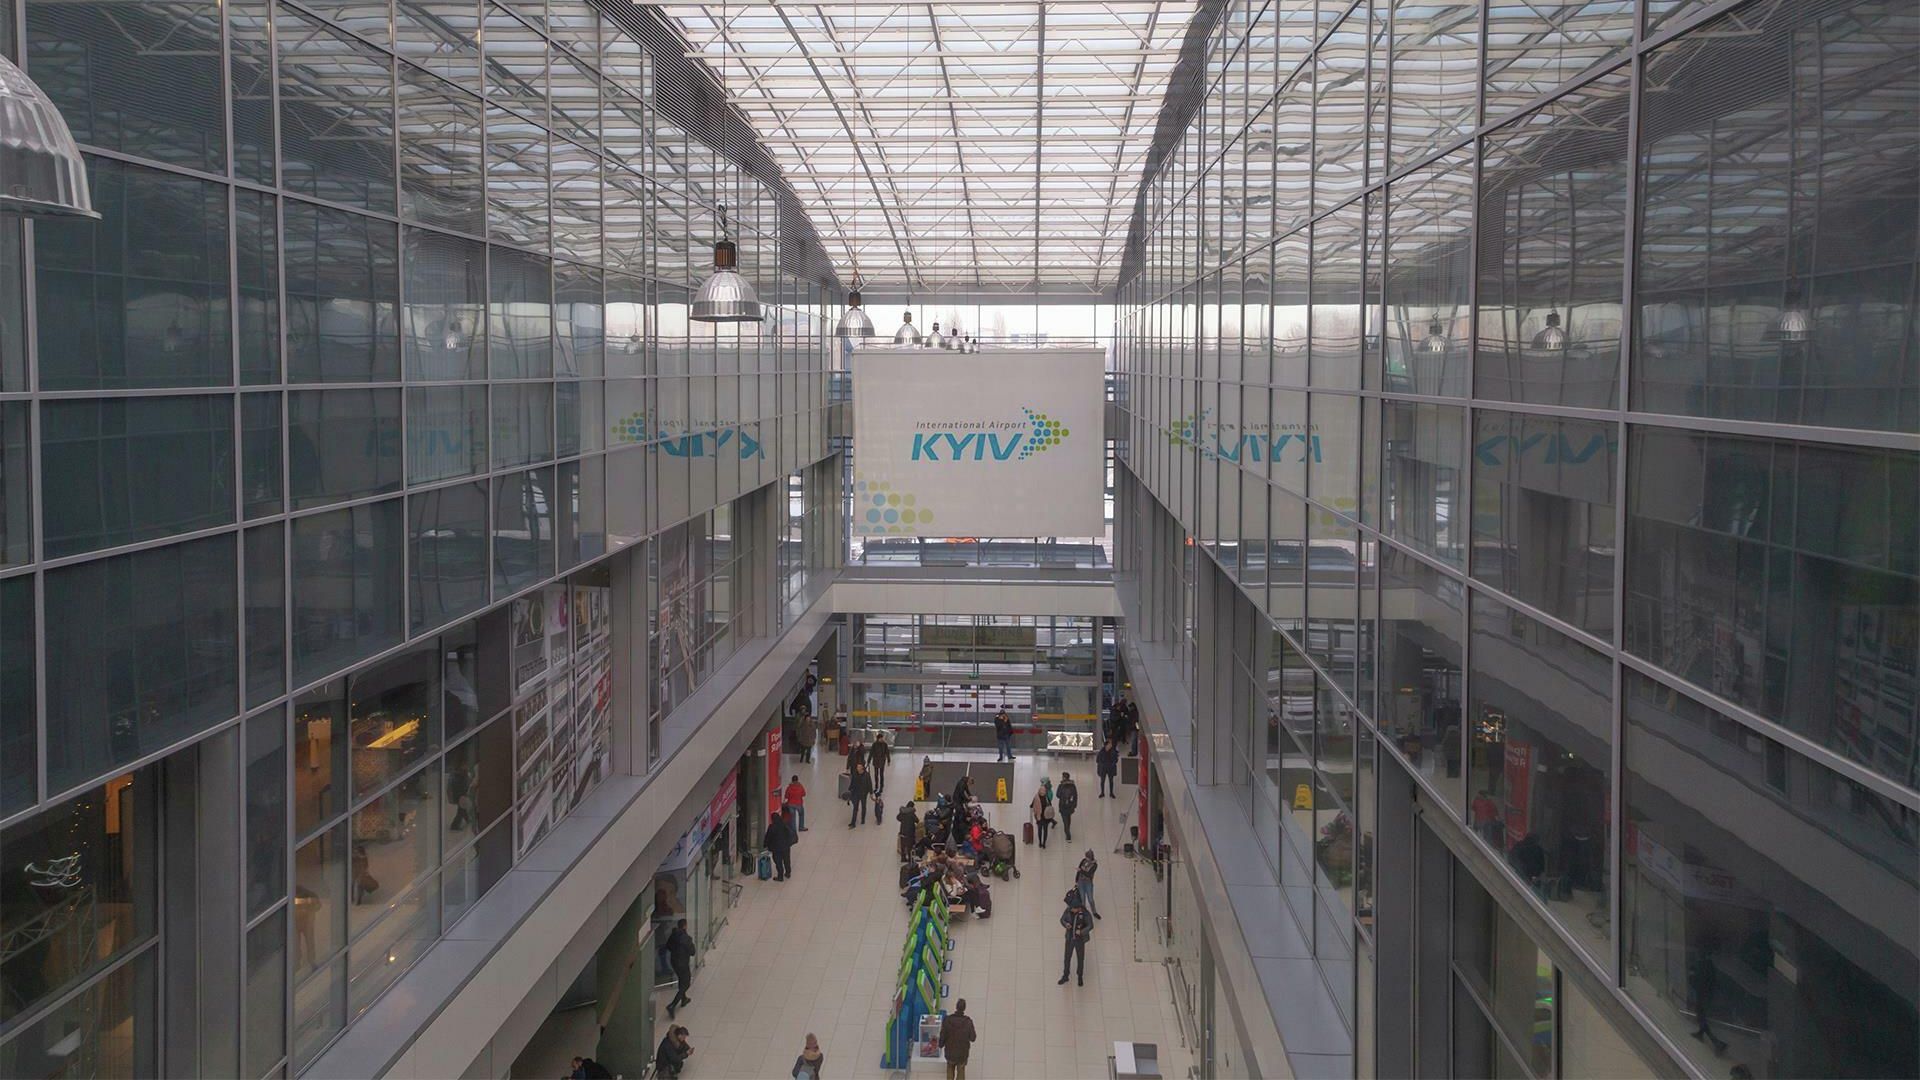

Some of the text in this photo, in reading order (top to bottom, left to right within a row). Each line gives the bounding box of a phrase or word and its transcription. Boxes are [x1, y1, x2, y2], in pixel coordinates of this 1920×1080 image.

[916, 421, 1027, 431] International Airport
[911, 433, 1023, 461] KYIV
